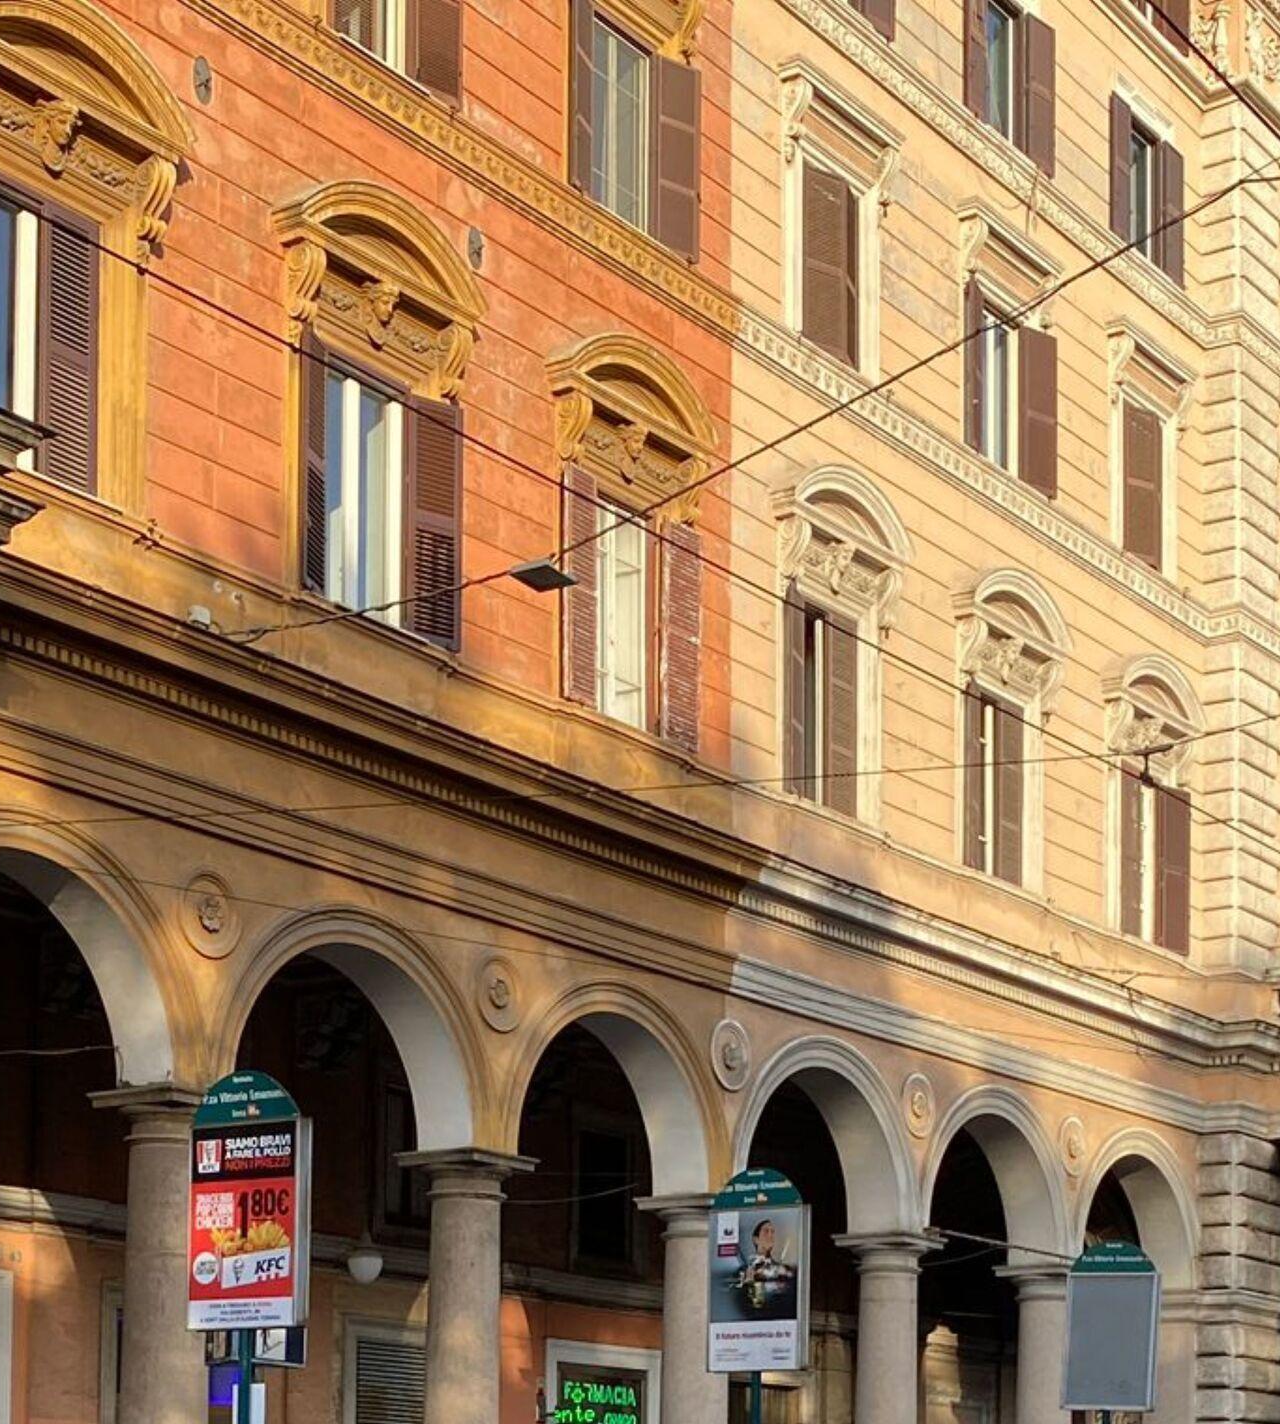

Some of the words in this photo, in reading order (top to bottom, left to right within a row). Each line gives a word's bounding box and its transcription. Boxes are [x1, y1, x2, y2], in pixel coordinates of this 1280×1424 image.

[224, 1136, 258, 1150] SIAMO
[260, 1133, 291, 1148] BRAVI
[263, 1146, 291, 1157] POLLO
[224, 1159, 248, 1171] NON
[254, 1156, 290, 1169] PREZZI
[254, 1255, 286, 1275] KFC
